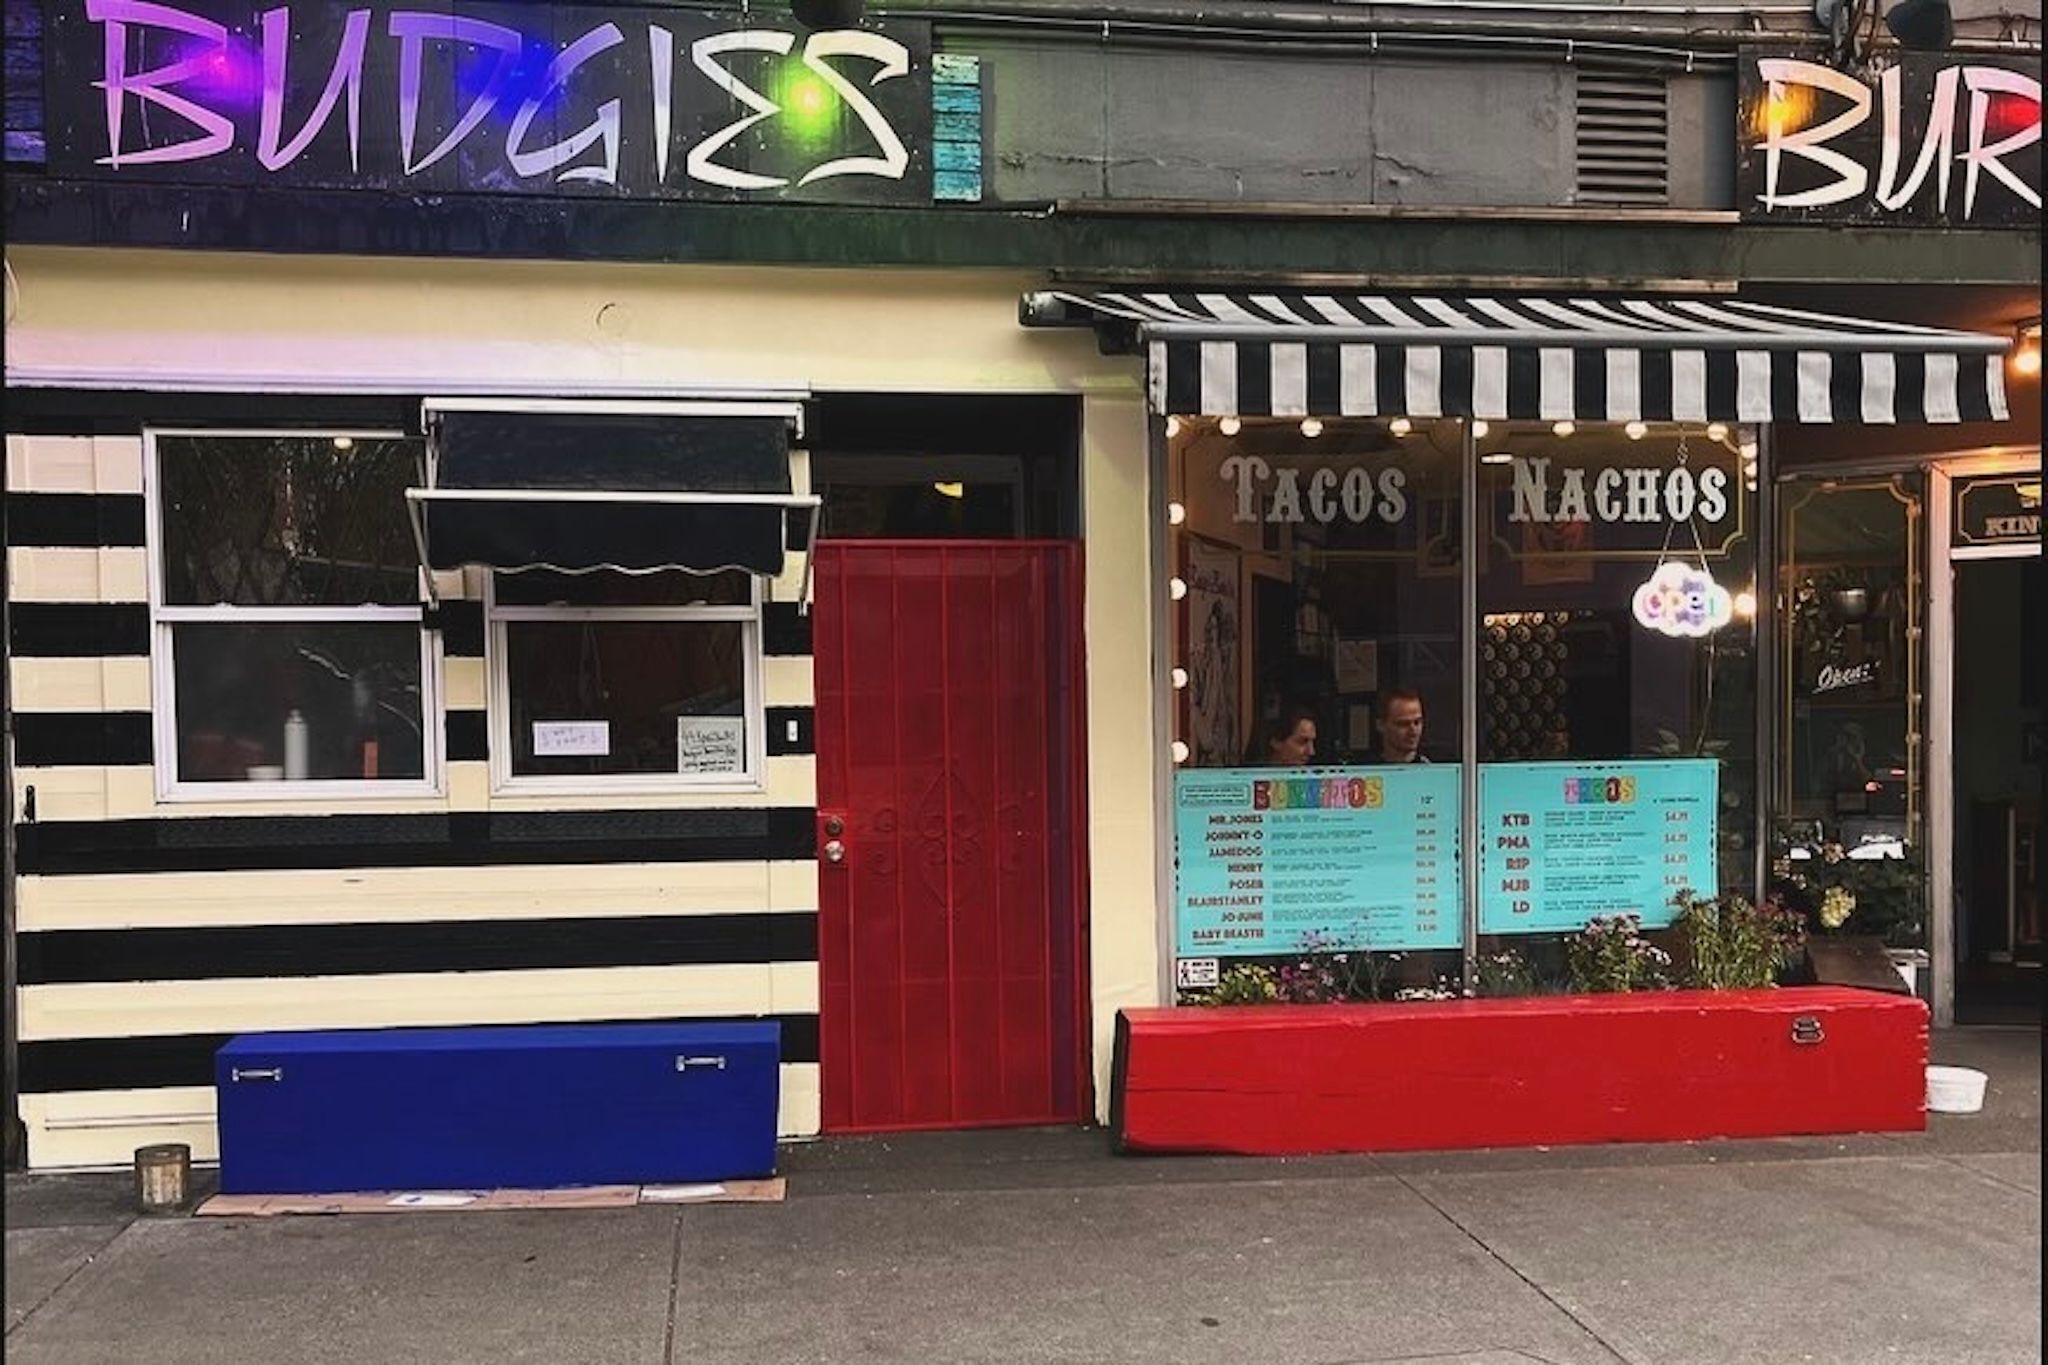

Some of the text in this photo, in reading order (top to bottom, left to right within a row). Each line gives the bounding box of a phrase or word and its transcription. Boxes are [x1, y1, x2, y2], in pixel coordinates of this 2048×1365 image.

[84, 0, 909, 189] BUDGIES
[1219, 455, 1407, 525] TACOS
[1508, 456, 1729, 524] NACHOS
[1984, 515, 2042, 536] KIN
